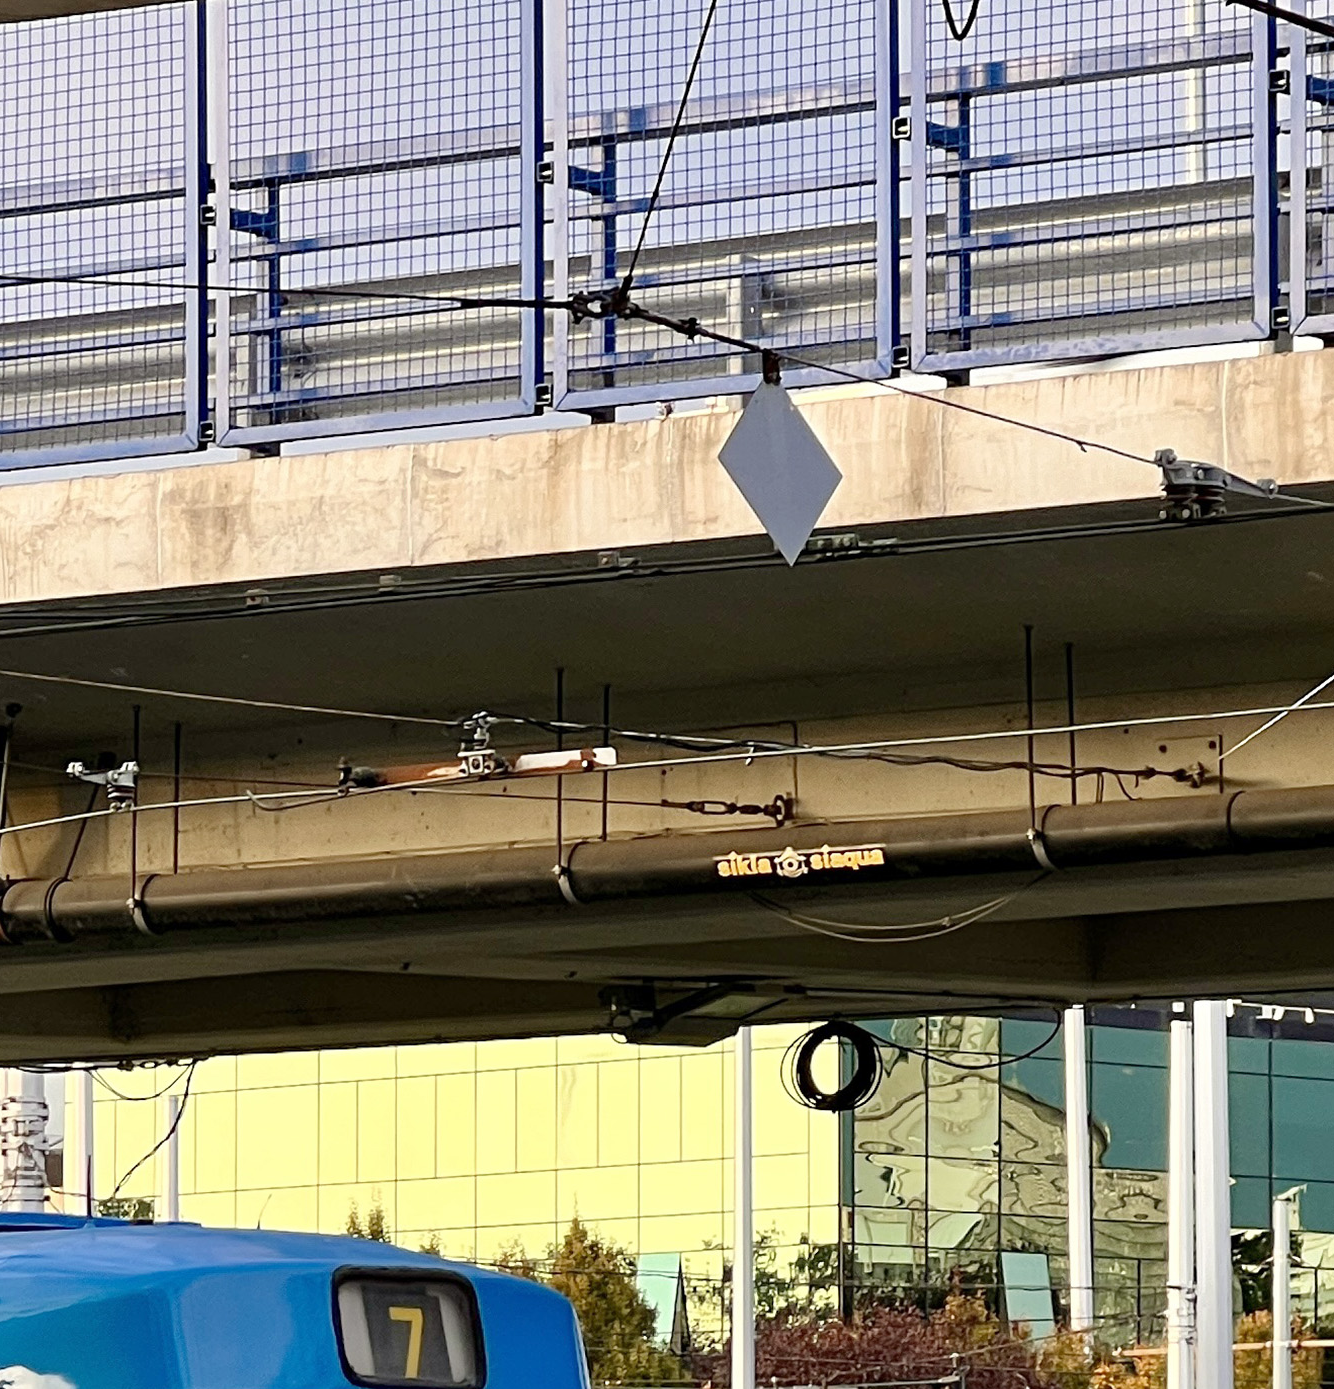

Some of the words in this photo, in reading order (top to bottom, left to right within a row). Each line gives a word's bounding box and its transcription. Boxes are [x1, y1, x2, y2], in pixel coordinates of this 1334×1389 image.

[717, 851, 772, 877] sikla
[810, 845, 885, 870] siaqua
[388, 1306, 424, 1379] 7
